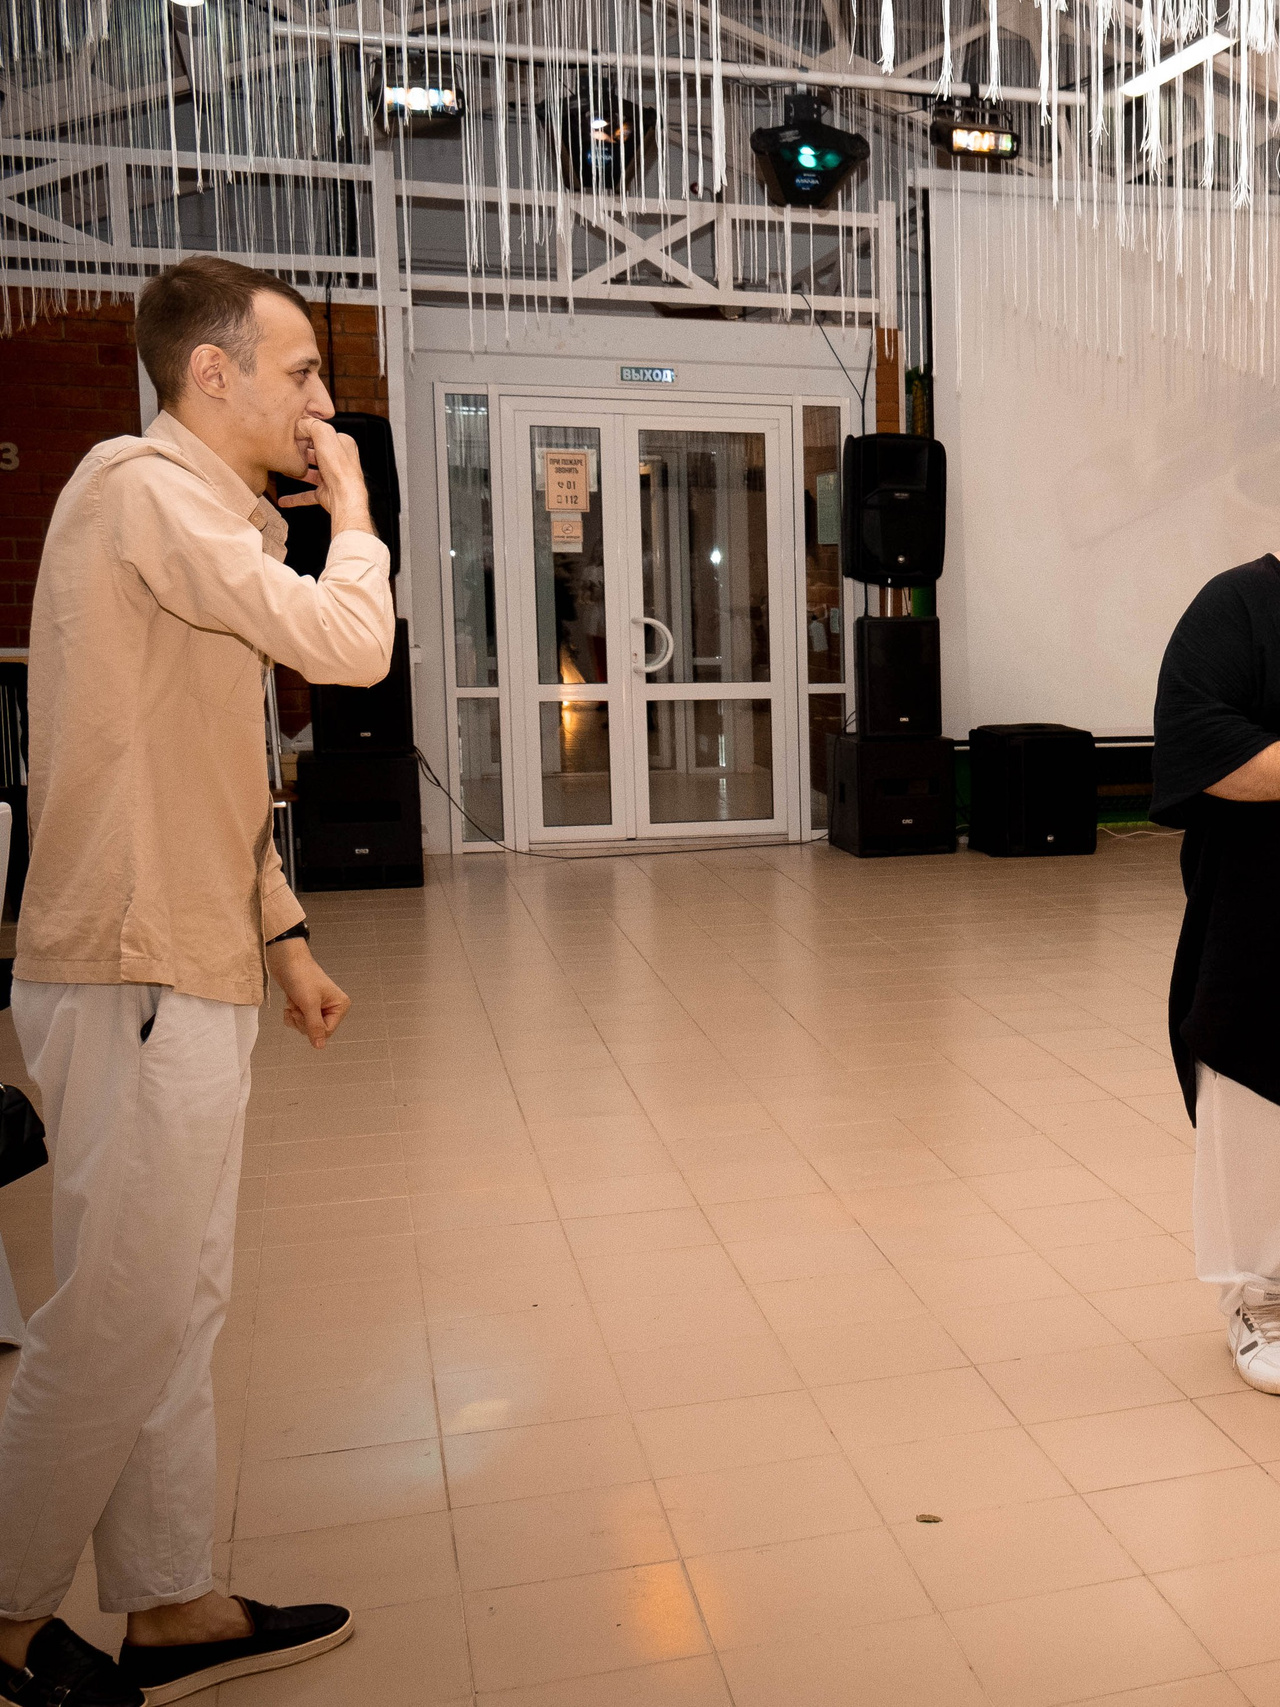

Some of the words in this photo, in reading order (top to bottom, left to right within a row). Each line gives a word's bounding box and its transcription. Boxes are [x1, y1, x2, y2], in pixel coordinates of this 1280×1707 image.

[622, 368, 673, 383] ВЫХОД
[549, 458, 561, 466] ПРИ
[561, 458, 584, 467] ПОЖАРЕ
[554, 466, 579, 475] ЗВОНИТЬ
[566, 480, 576, 490] 01
[565, 495, 579, 505] 112
